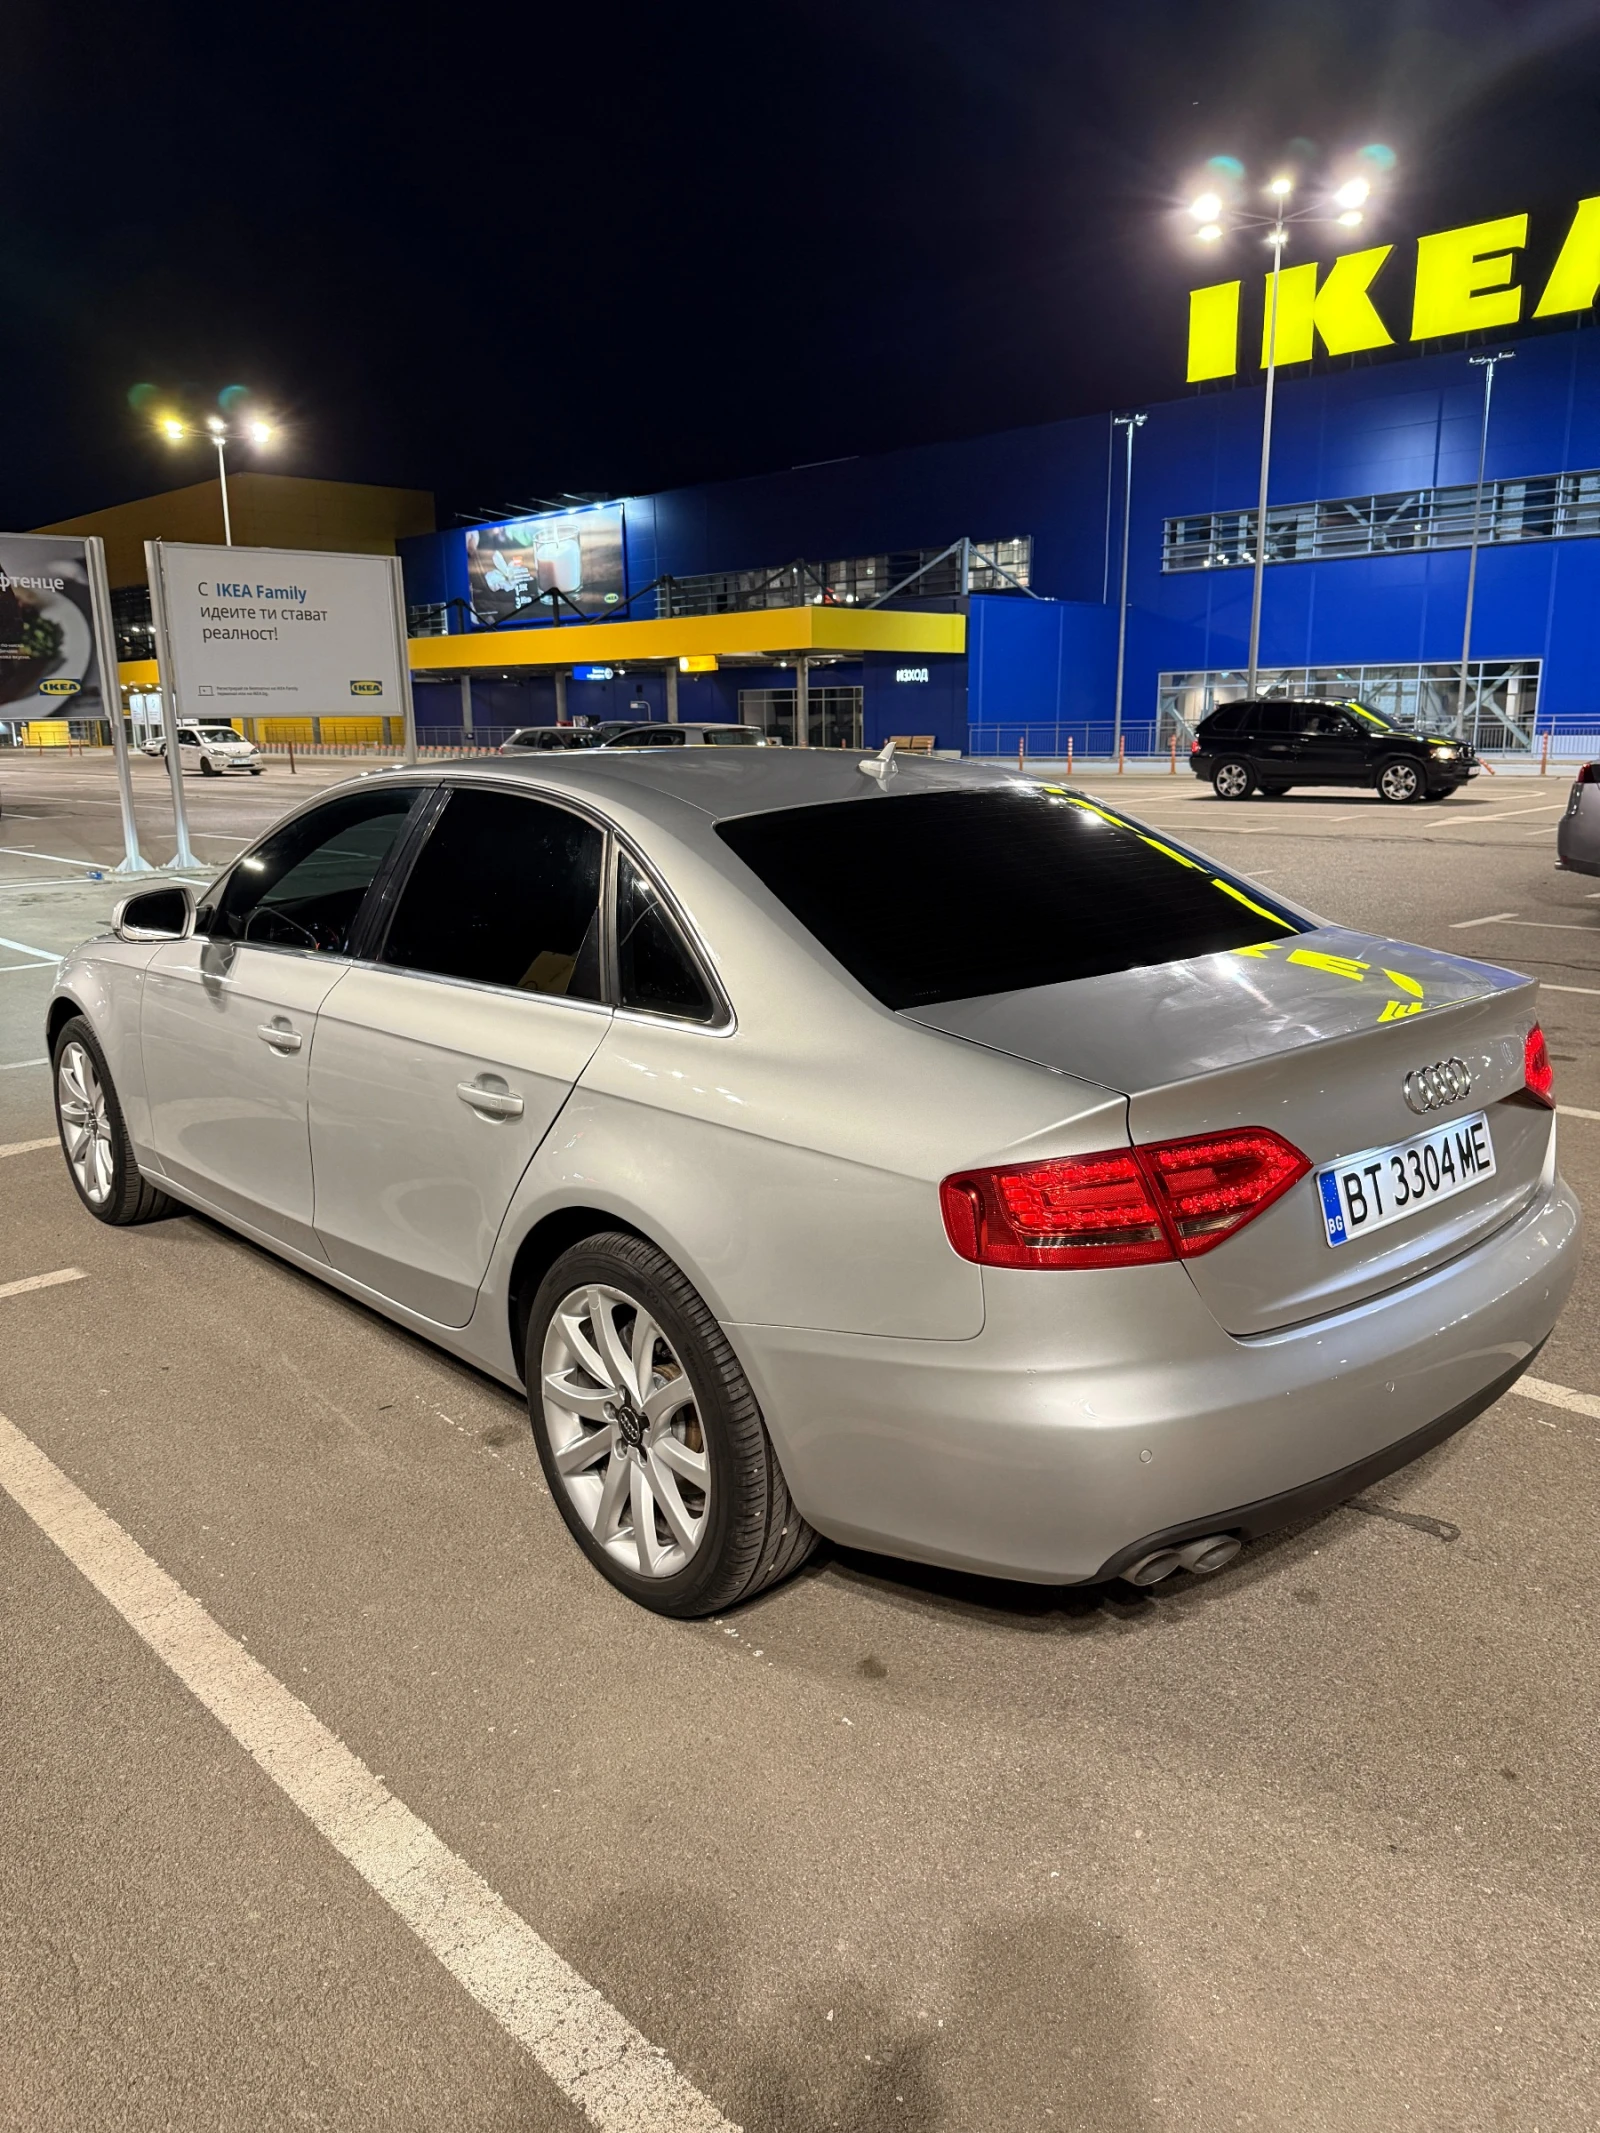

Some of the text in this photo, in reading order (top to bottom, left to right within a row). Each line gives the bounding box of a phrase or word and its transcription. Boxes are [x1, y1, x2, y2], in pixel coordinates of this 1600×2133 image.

[198, 582, 307, 604] С IKEA Family
[200, 606, 328, 621] идеите ти стават
[203, 627, 278, 643] реалност!
[896, 668, 928, 682] ИЗХОД
[43, 683, 78, 691] IKEA
[1343, 1122, 1490, 1226] BT 3304 ME
[1327, 1216, 1344, 1234] BG
